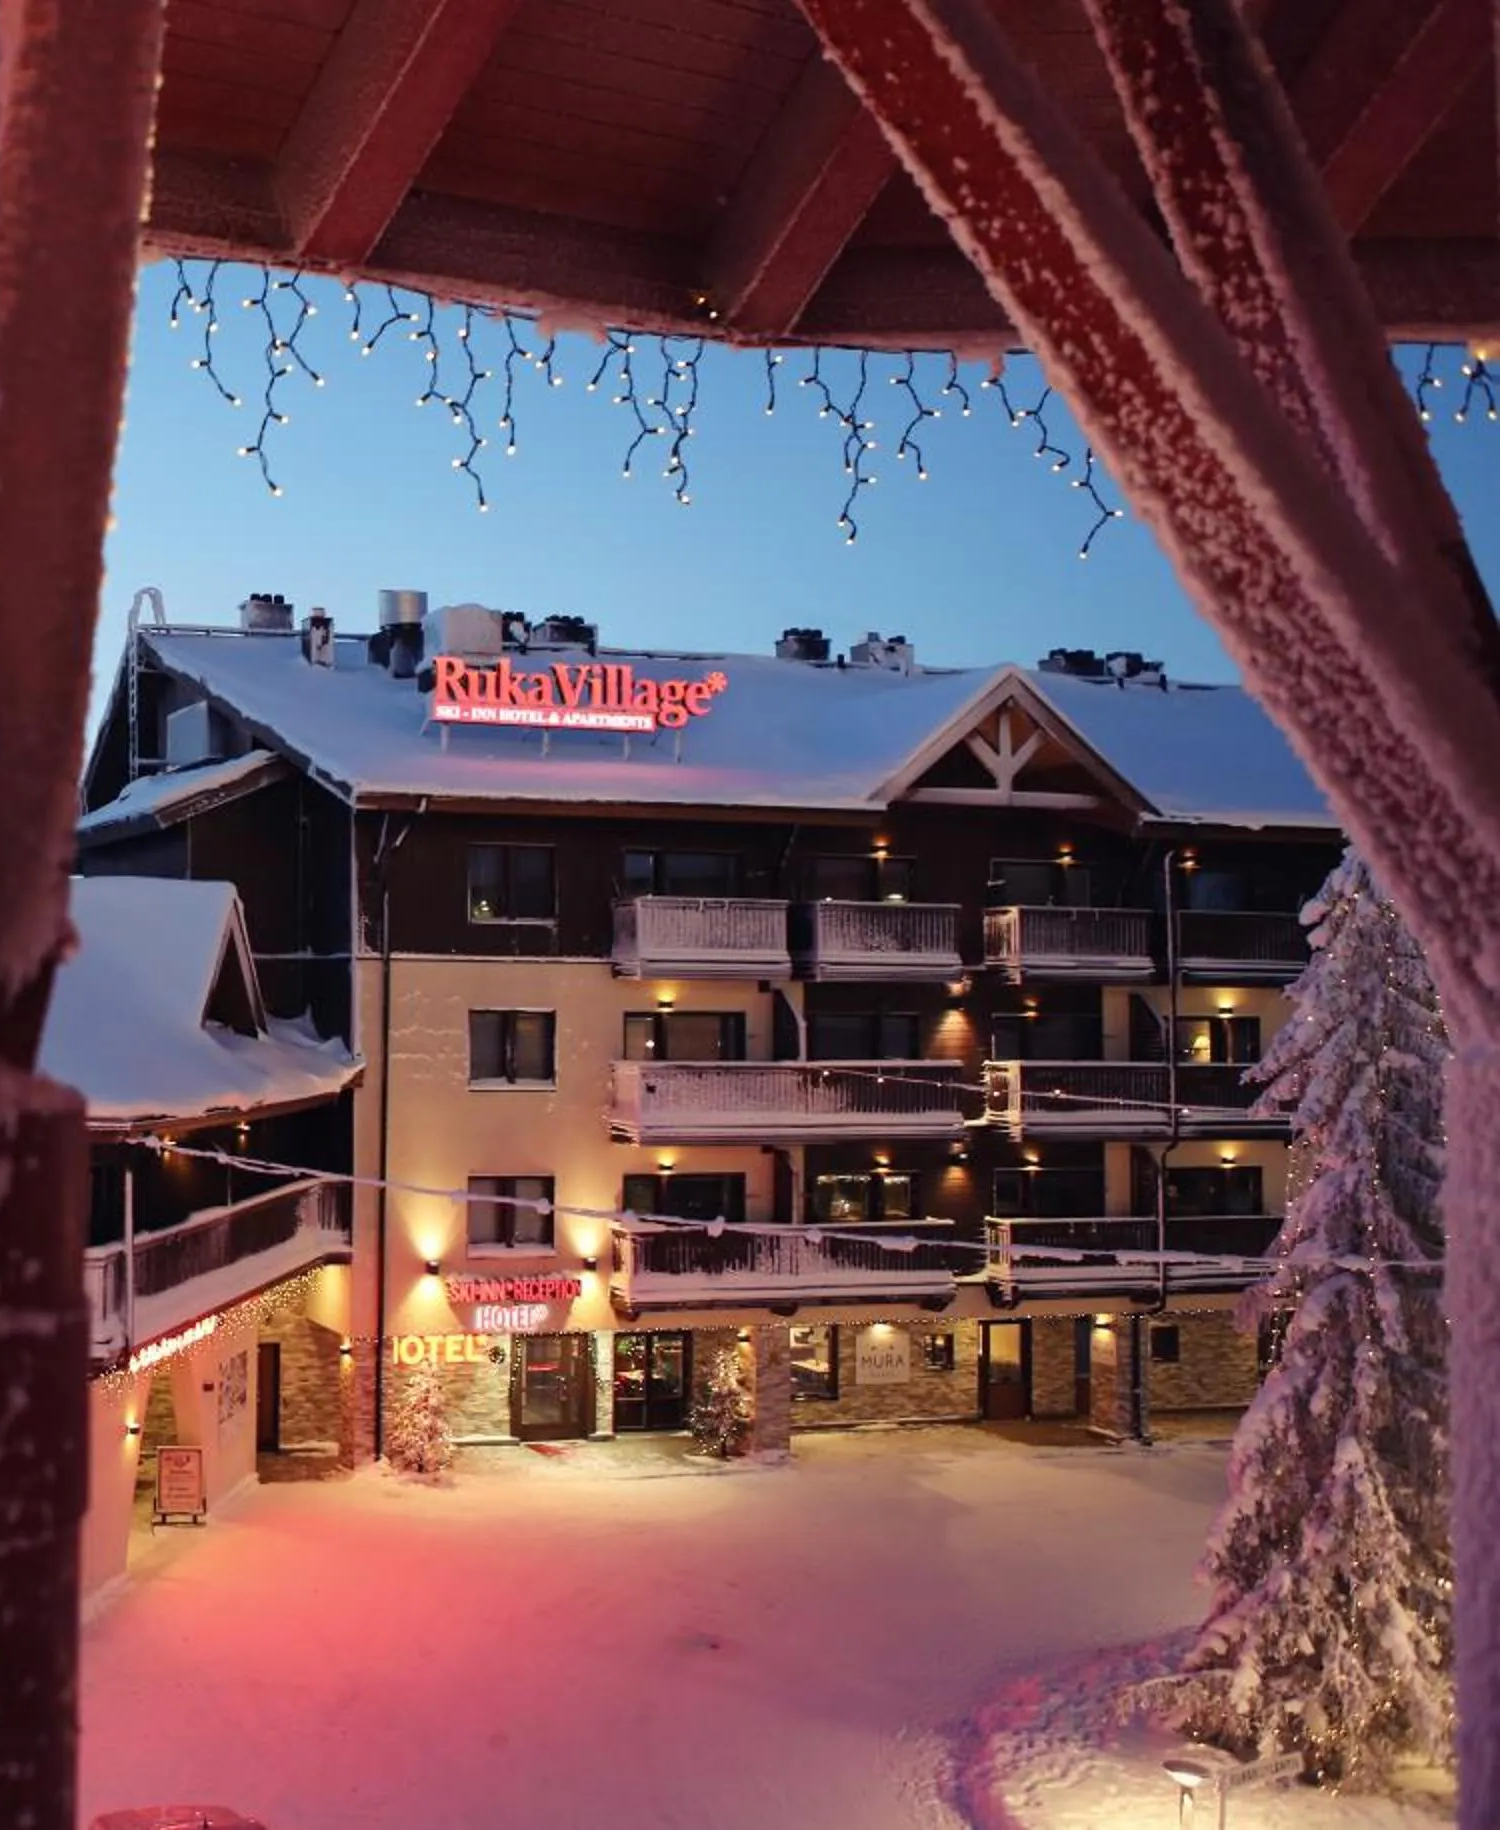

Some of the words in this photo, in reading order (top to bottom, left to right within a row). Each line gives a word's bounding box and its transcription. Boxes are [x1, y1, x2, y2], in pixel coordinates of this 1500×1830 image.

[499, 709, 546, 724] HOTEL
[562, 712, 653, 731] APARTMENTS
[474, 1304, 536, 1331] HOTEL
[861, 1353, 905, 1369] MURA
